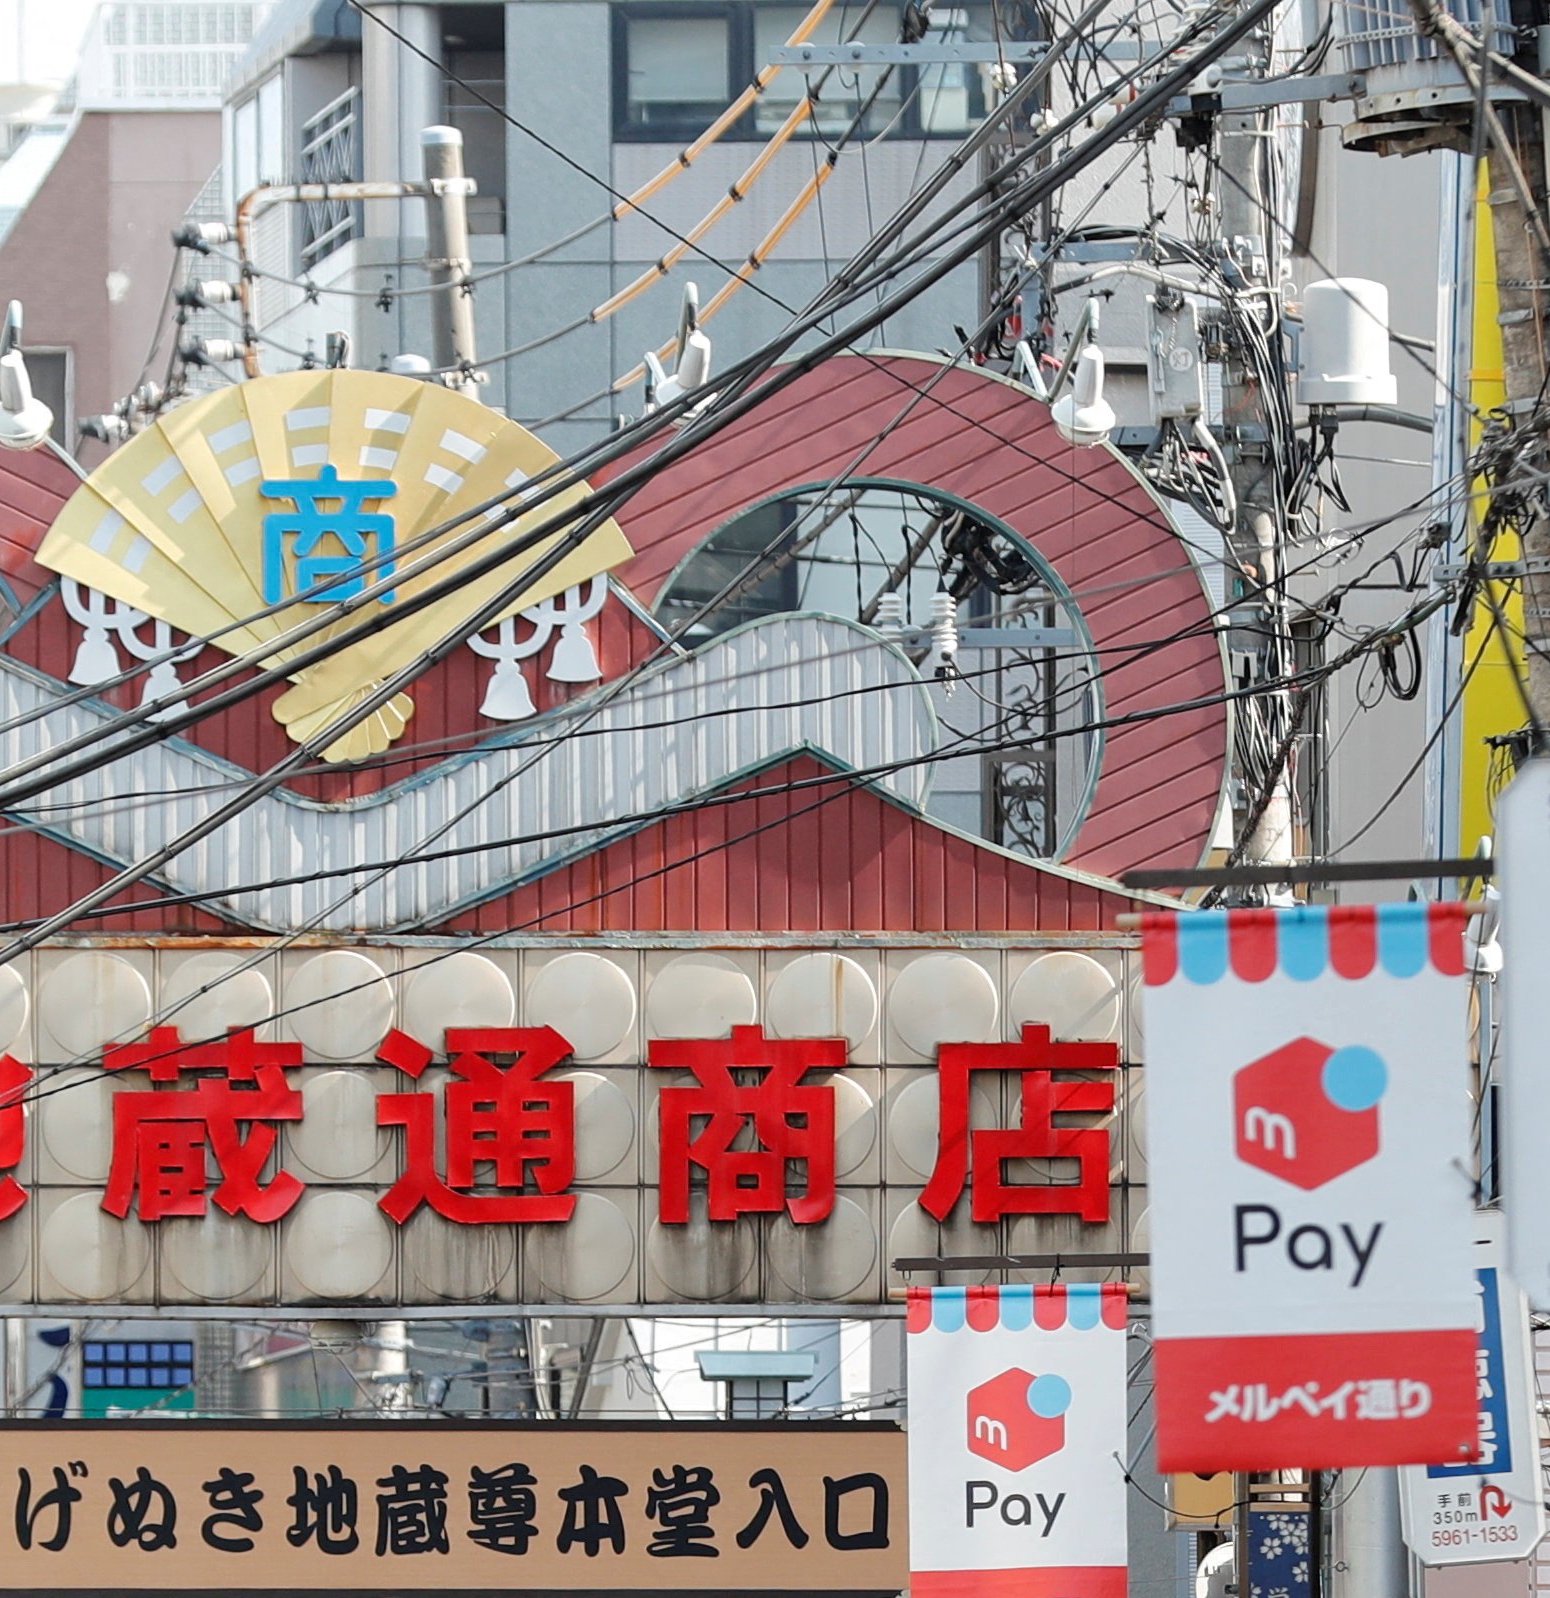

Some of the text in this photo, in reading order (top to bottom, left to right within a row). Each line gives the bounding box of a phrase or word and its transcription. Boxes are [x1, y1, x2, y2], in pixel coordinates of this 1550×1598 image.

[260, 464, 398, 604] 商
[1234, 1203, 1384, 1287] Pay
[1206, 1379, 1431, 1424] メルペイ通り
[966, 1480, 1067, 1537] Pay
[1433, 1510, 1478, 1525] 350m
[1432, 1525, 1518, 1547] 5961-1533
